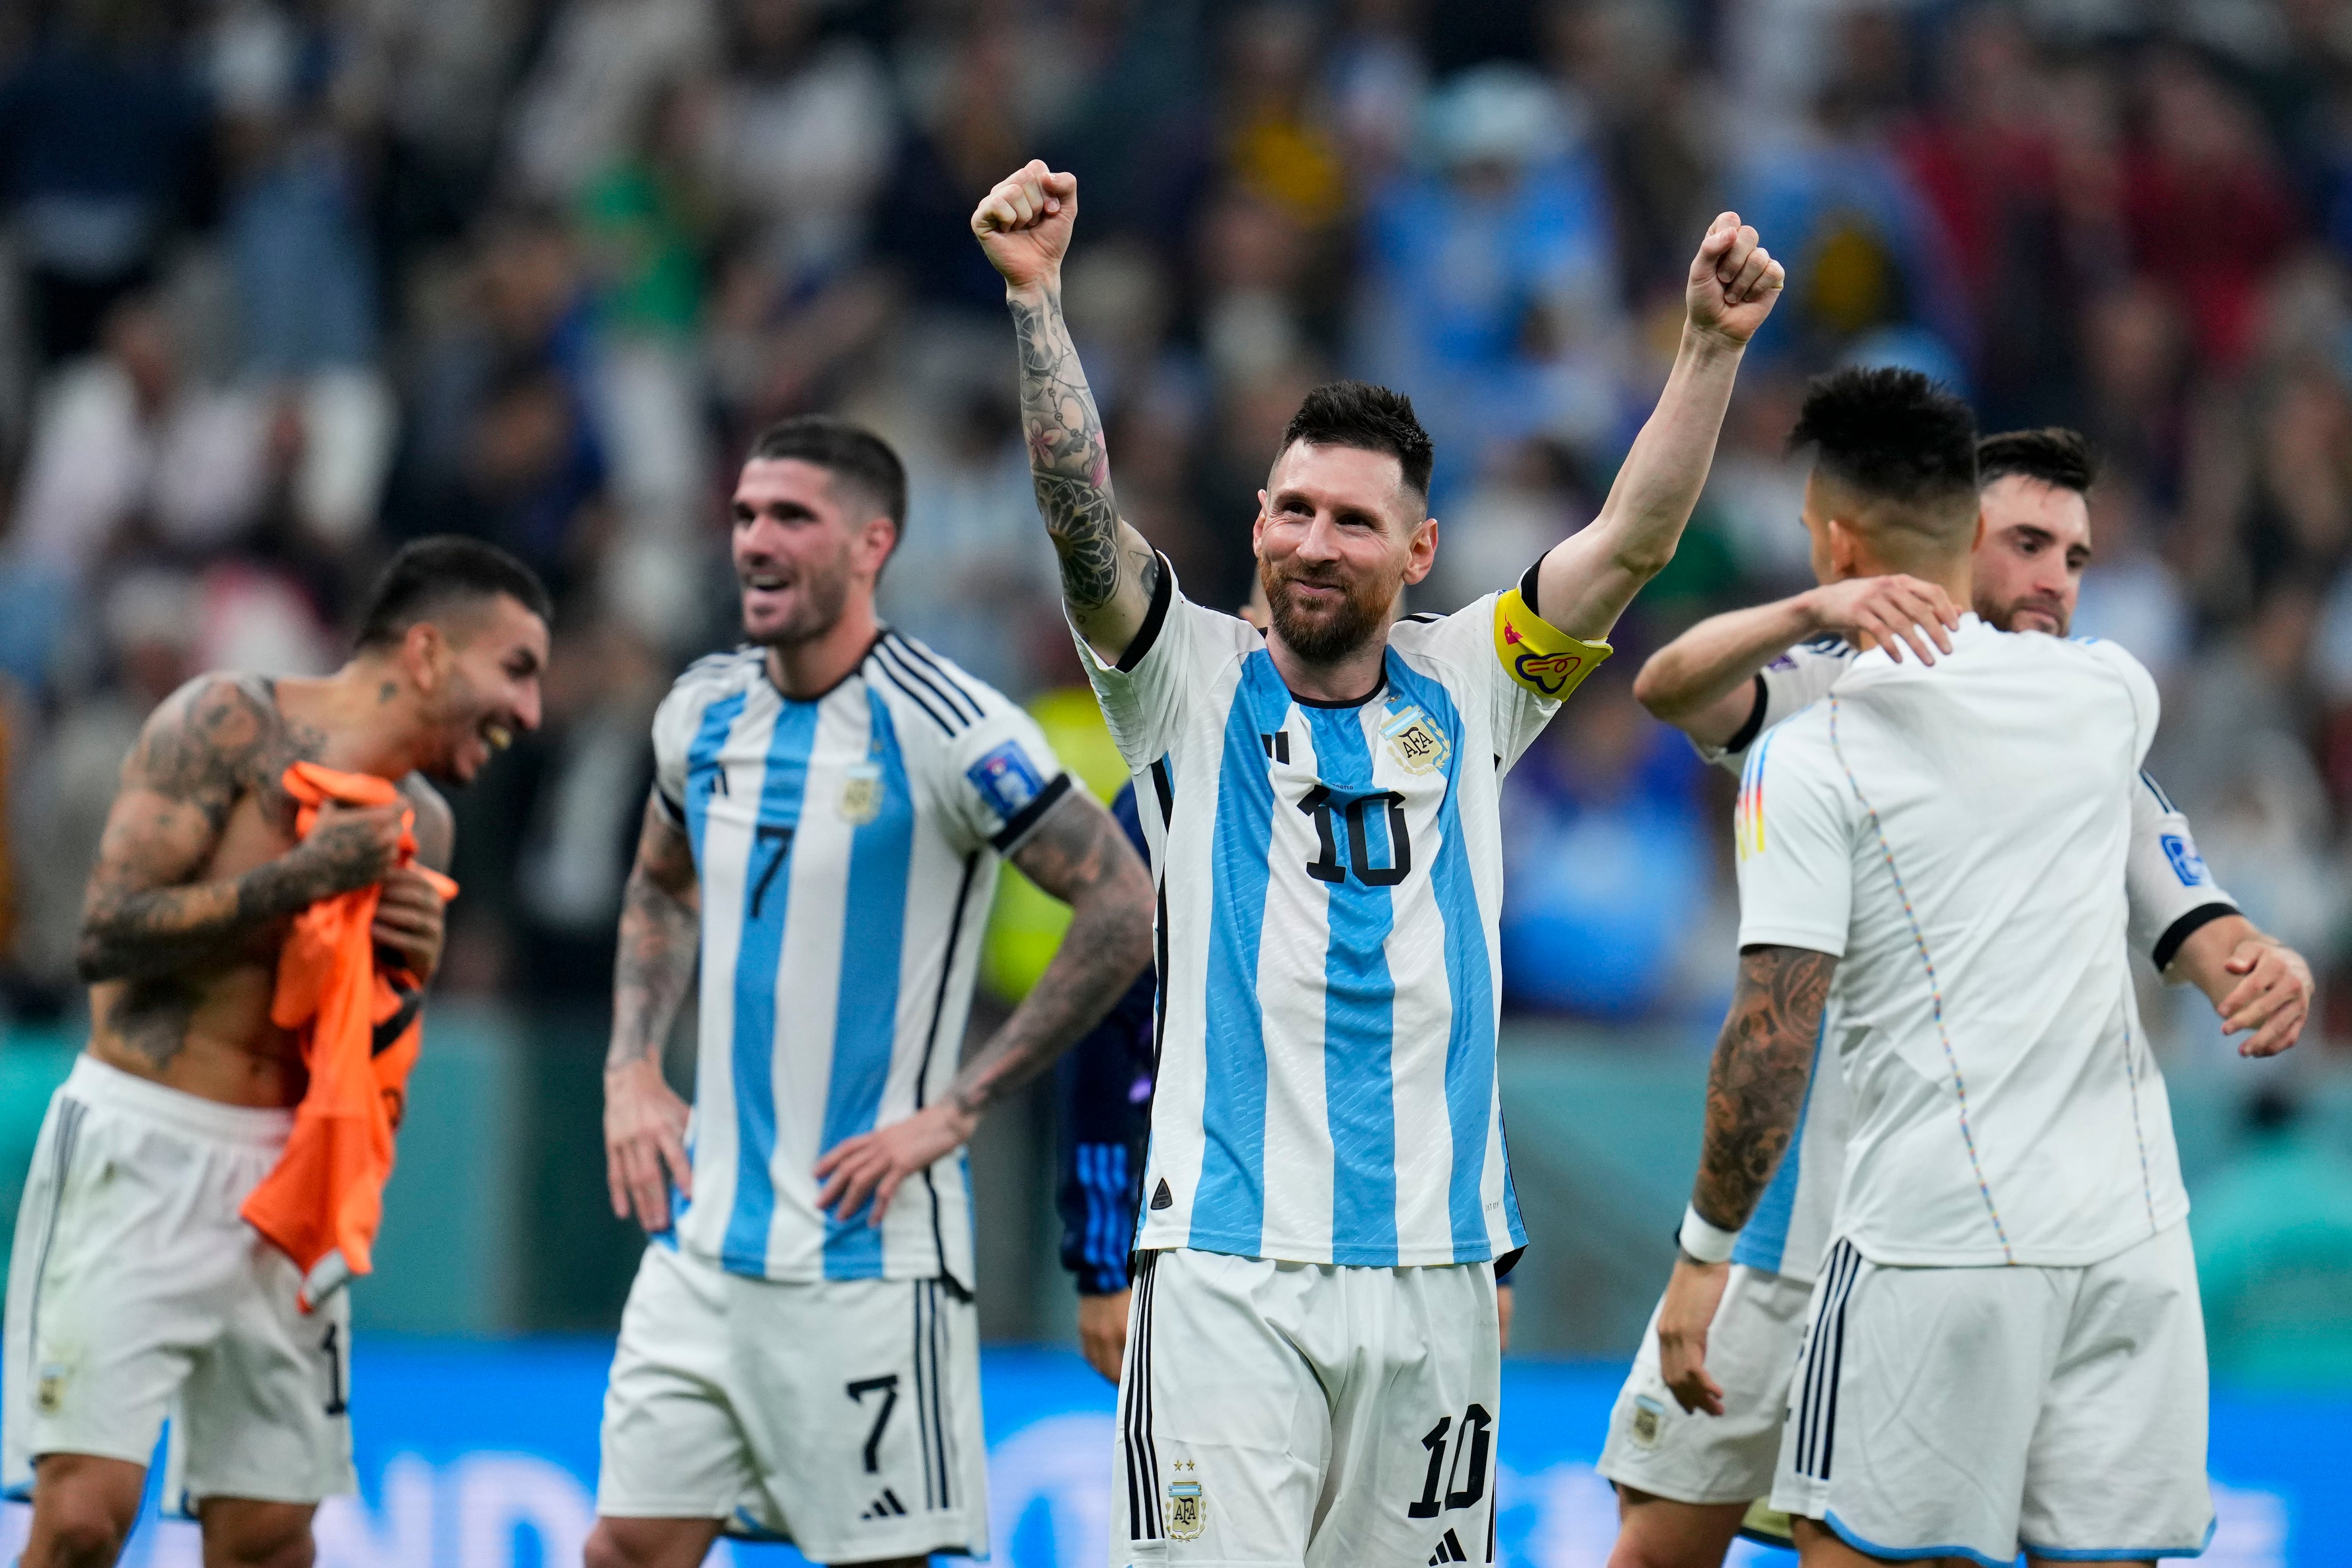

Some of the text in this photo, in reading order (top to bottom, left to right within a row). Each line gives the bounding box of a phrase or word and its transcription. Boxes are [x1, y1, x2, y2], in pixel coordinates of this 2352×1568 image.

[1398, 727, 1433, 758] AFA
[751, 824, 795, 919] 7
[1297, 784, 1411, 886] 10
[847, 1374, 897, 1472] 7
[1408, 1403, 1491, 1518] 10
[1174, 1497, 1196, 1525] AFA
